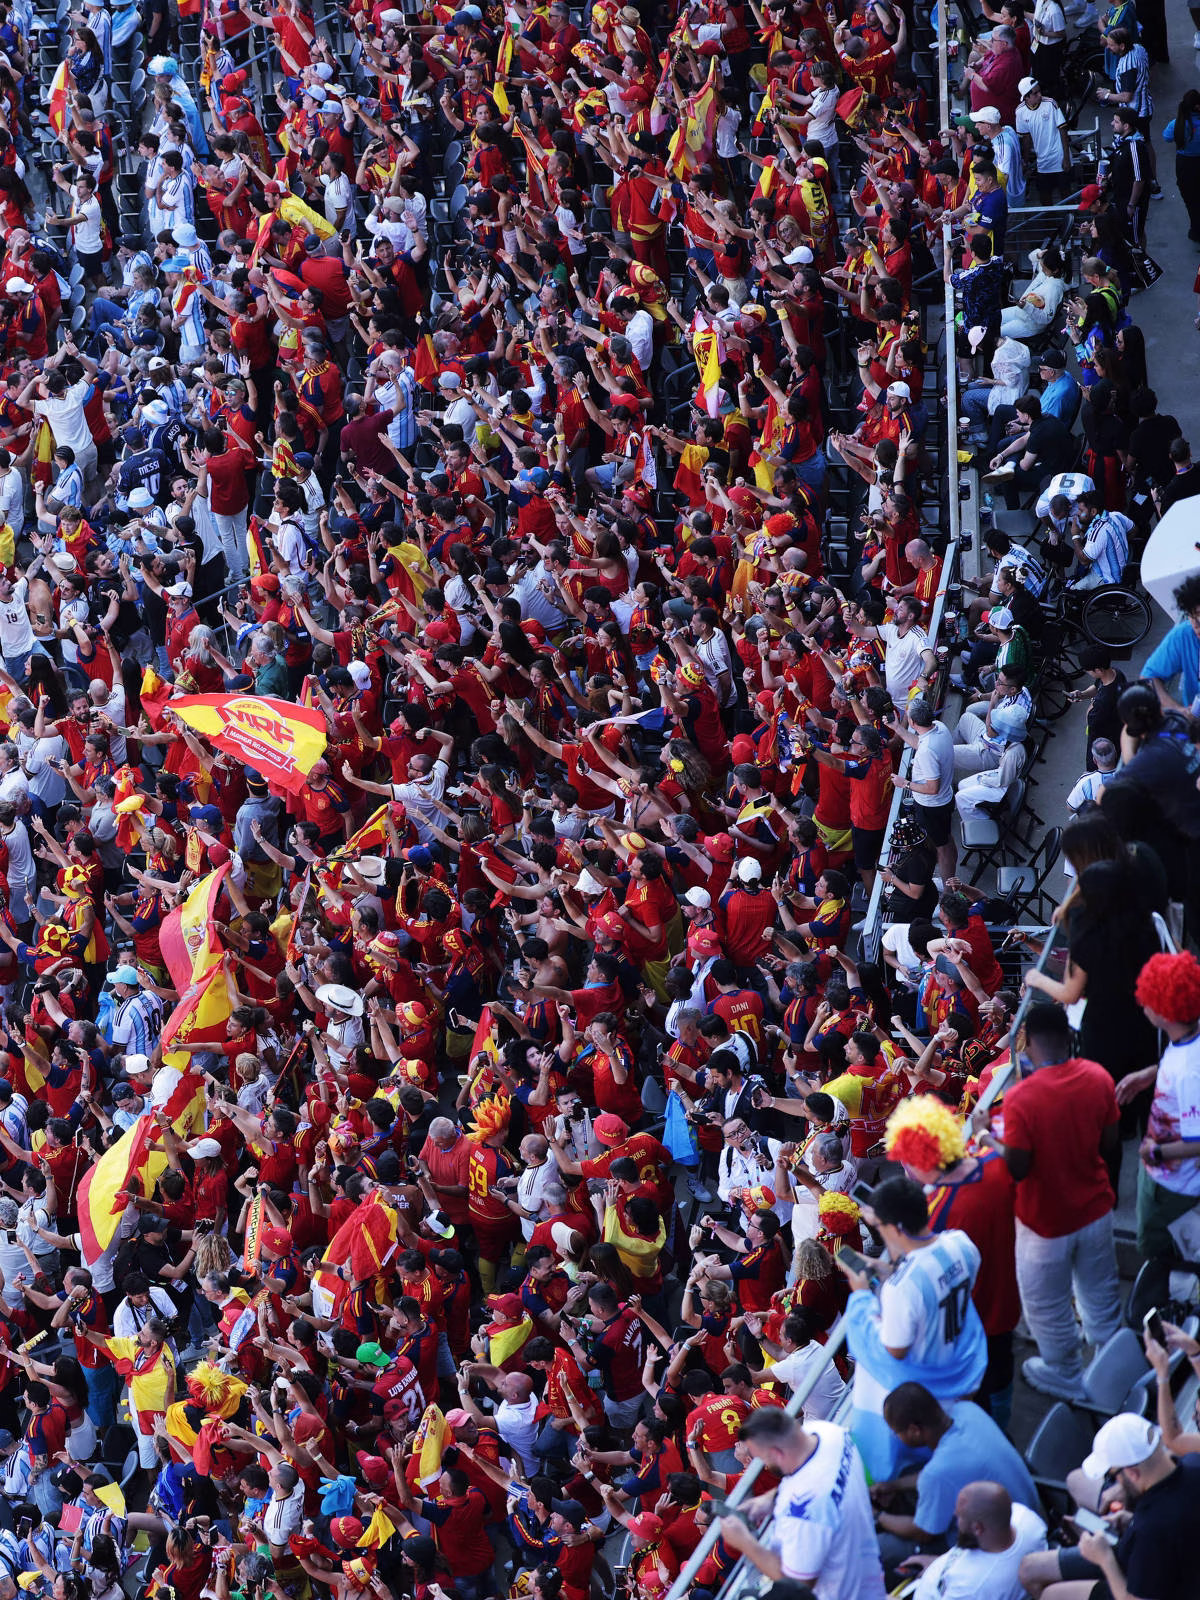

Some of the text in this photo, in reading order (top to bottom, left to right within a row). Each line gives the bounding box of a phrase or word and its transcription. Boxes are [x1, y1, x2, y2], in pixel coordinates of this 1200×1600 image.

[139, 461, 160, 476] MESSI
[141, 473, 160, 494] 10
[6, 612, 18, 624] 19
[215, 707, 294, 744] MRF
[144, 1005, 162, 1031] 10
[731, 1003, 749, 1014] DANI
[730, 1014, 760, 1042] 10
[469, 1156, 488, 1197] 59
[939, 1278, 971, 1346] 10
[388, 1381, 404, 1398] LUIS
[402, 1381, 427, 1422] 21
[721, 1409, 742, 1435] 8
